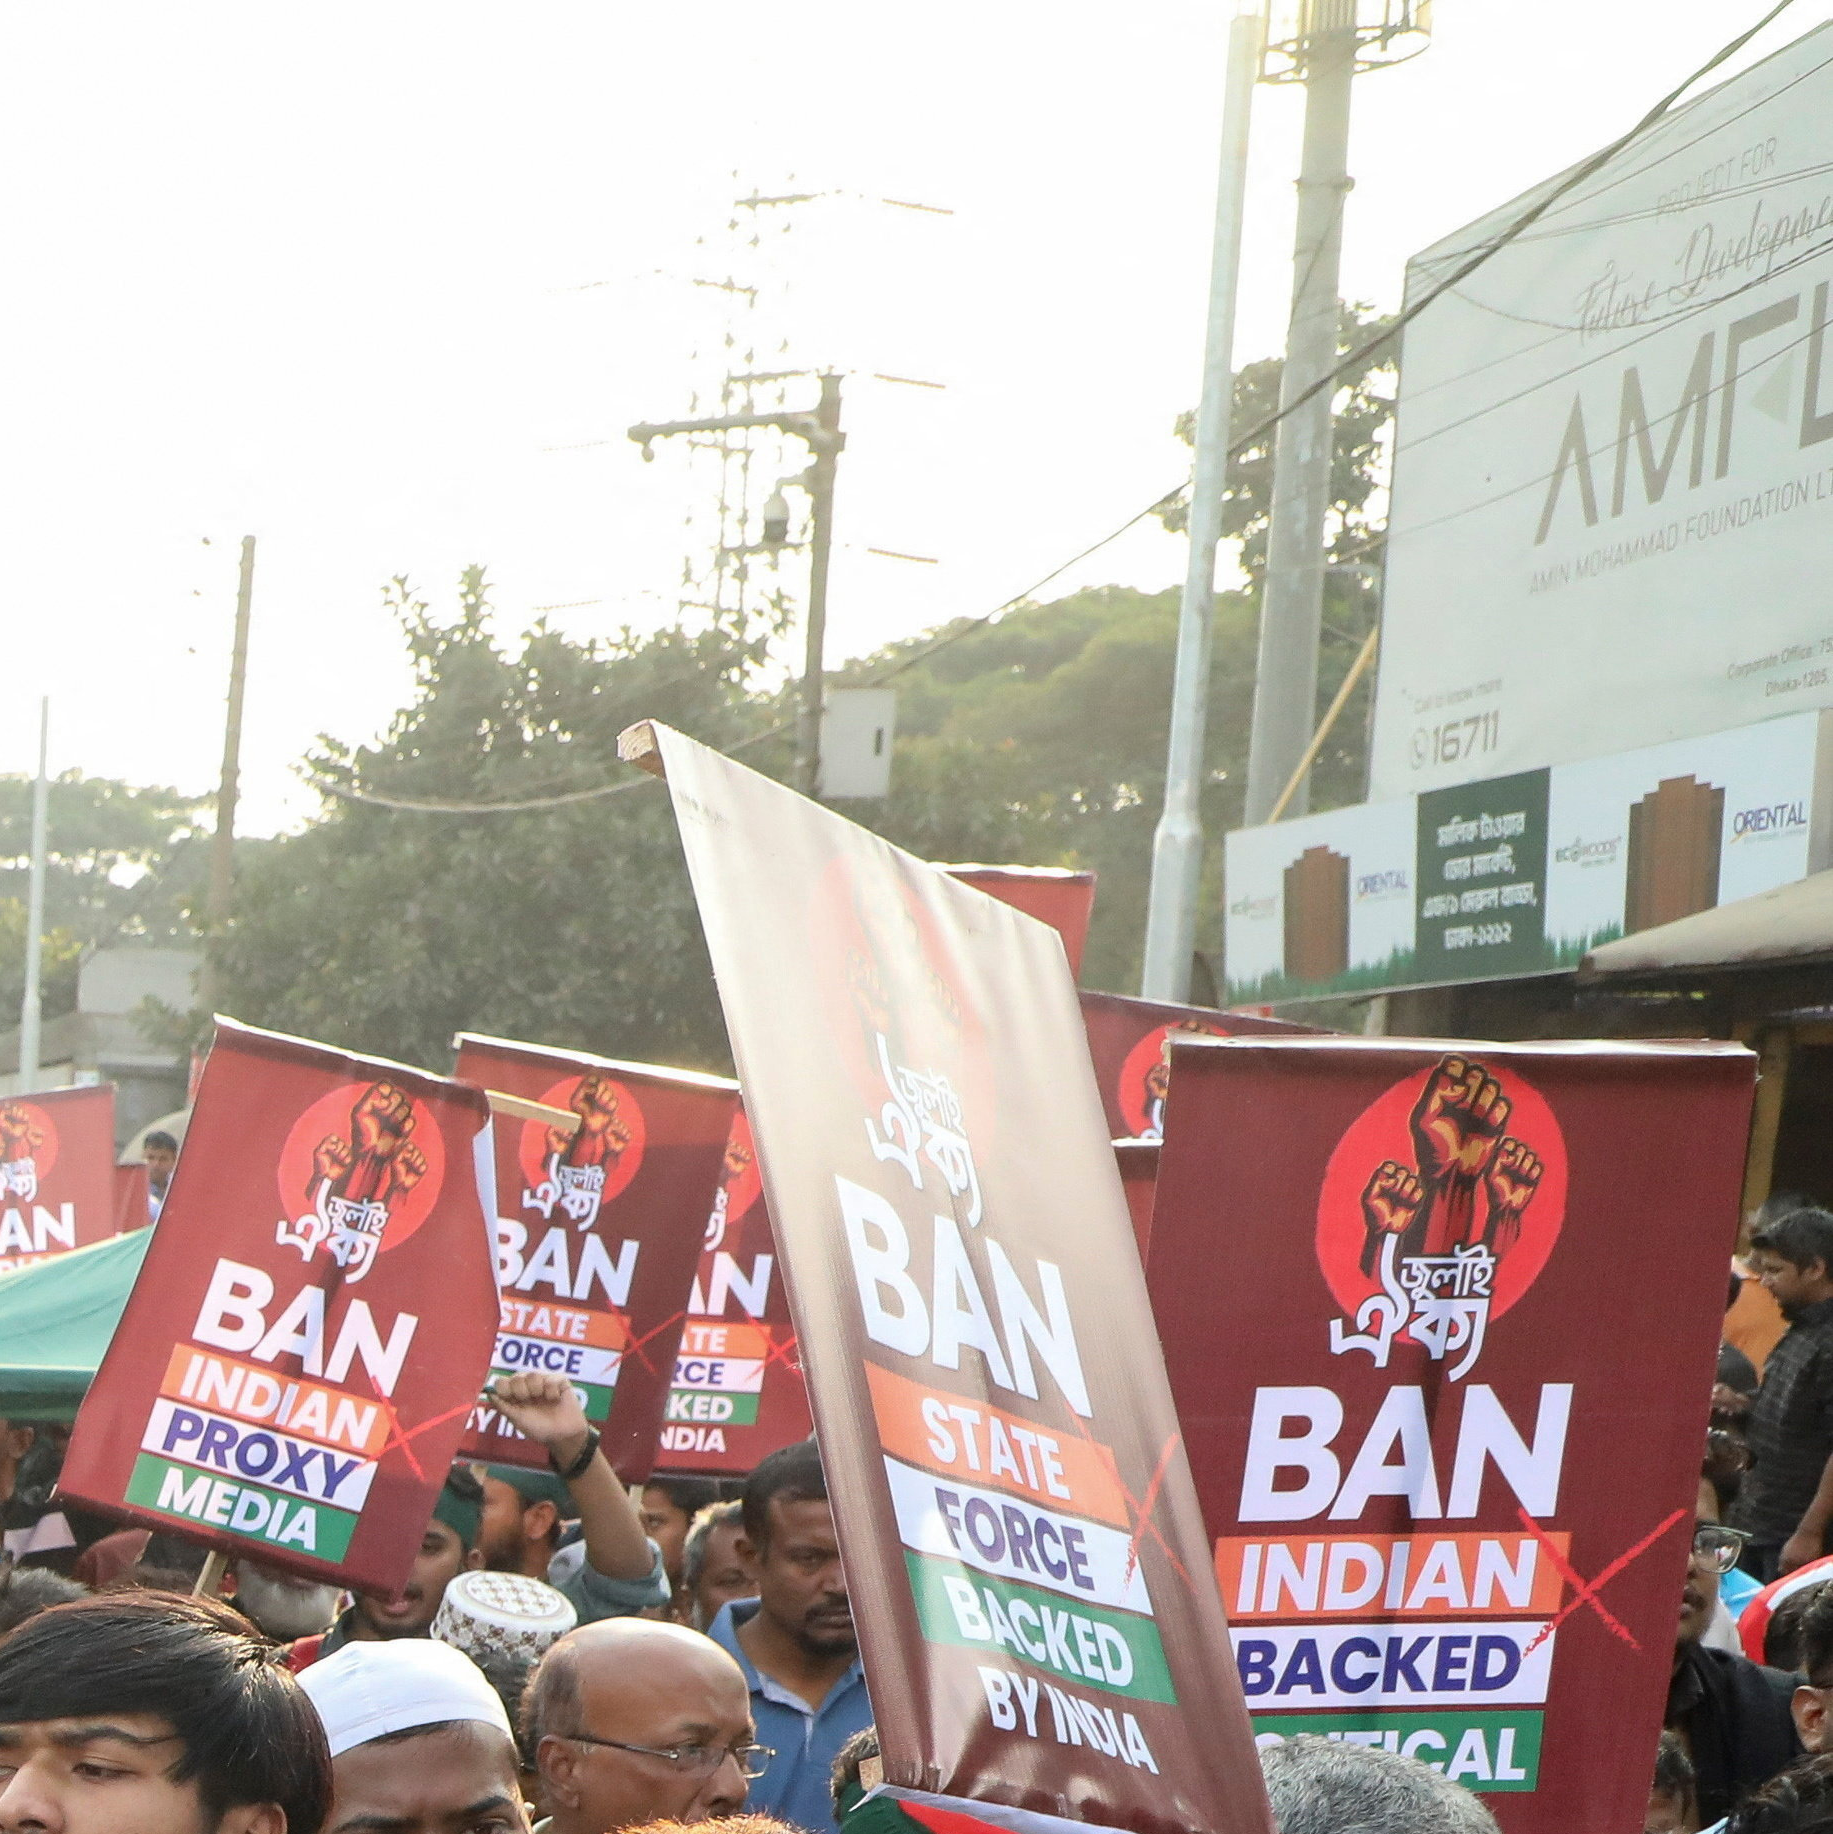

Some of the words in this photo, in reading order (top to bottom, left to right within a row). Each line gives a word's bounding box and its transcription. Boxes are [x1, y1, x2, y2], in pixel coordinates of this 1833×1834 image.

[1740, 136, 1777, 179] FOR
[1576, 521, 1678, 580] MOHAMMAD
[1685, 475, 1809, 544] FOUNDATION
[1433, 709, 1500, 766] 16711
[1733, 803, 1808, 834] ORIENTAL
[864, 1032, 982, 1228] ঐক্য
[275, 1176, 381, 1285] ঐক্য
[327, 1194, 391, 1238] জুলাই
[522, 1153, 600, 1232] ঐক্য
[496, 1215, 640, 1308] BAN
[835, 1173, 1094, 1419] BAN
[1329, 1232, 1490, 1384] ঐক্য
[1399, 1244, 1498, 1300] জুলাই
[191, 1256, 419, 1398] BAN
[500, 1301, 590, 1340] STATE
[179, 1353, 378, 1450] INDIAN
[668, 1394, 734, 1422] KED
[676, 1360, 726, 1386] RCE
[161, 1407, 357, 1500] PROXY
[660, 1426, 727, 1454] NDIA
[921, 1397, 1071, 1500] STATE
[1237, 1382, 1575, 1523] BAN
[155, 1466, 318, 1552] MEDIA
[934, 1486, 1095, 1592] FORCE
[1235, 1539, 1539, 1614] INDIAN
[942, 1574, 1134, 1688] BACKED
[1236, 1634, 1523, 1697] BACKED
[976, 1665, 1038, 1738] BY
[1044, 1682, 1160, 1776] INDIA
